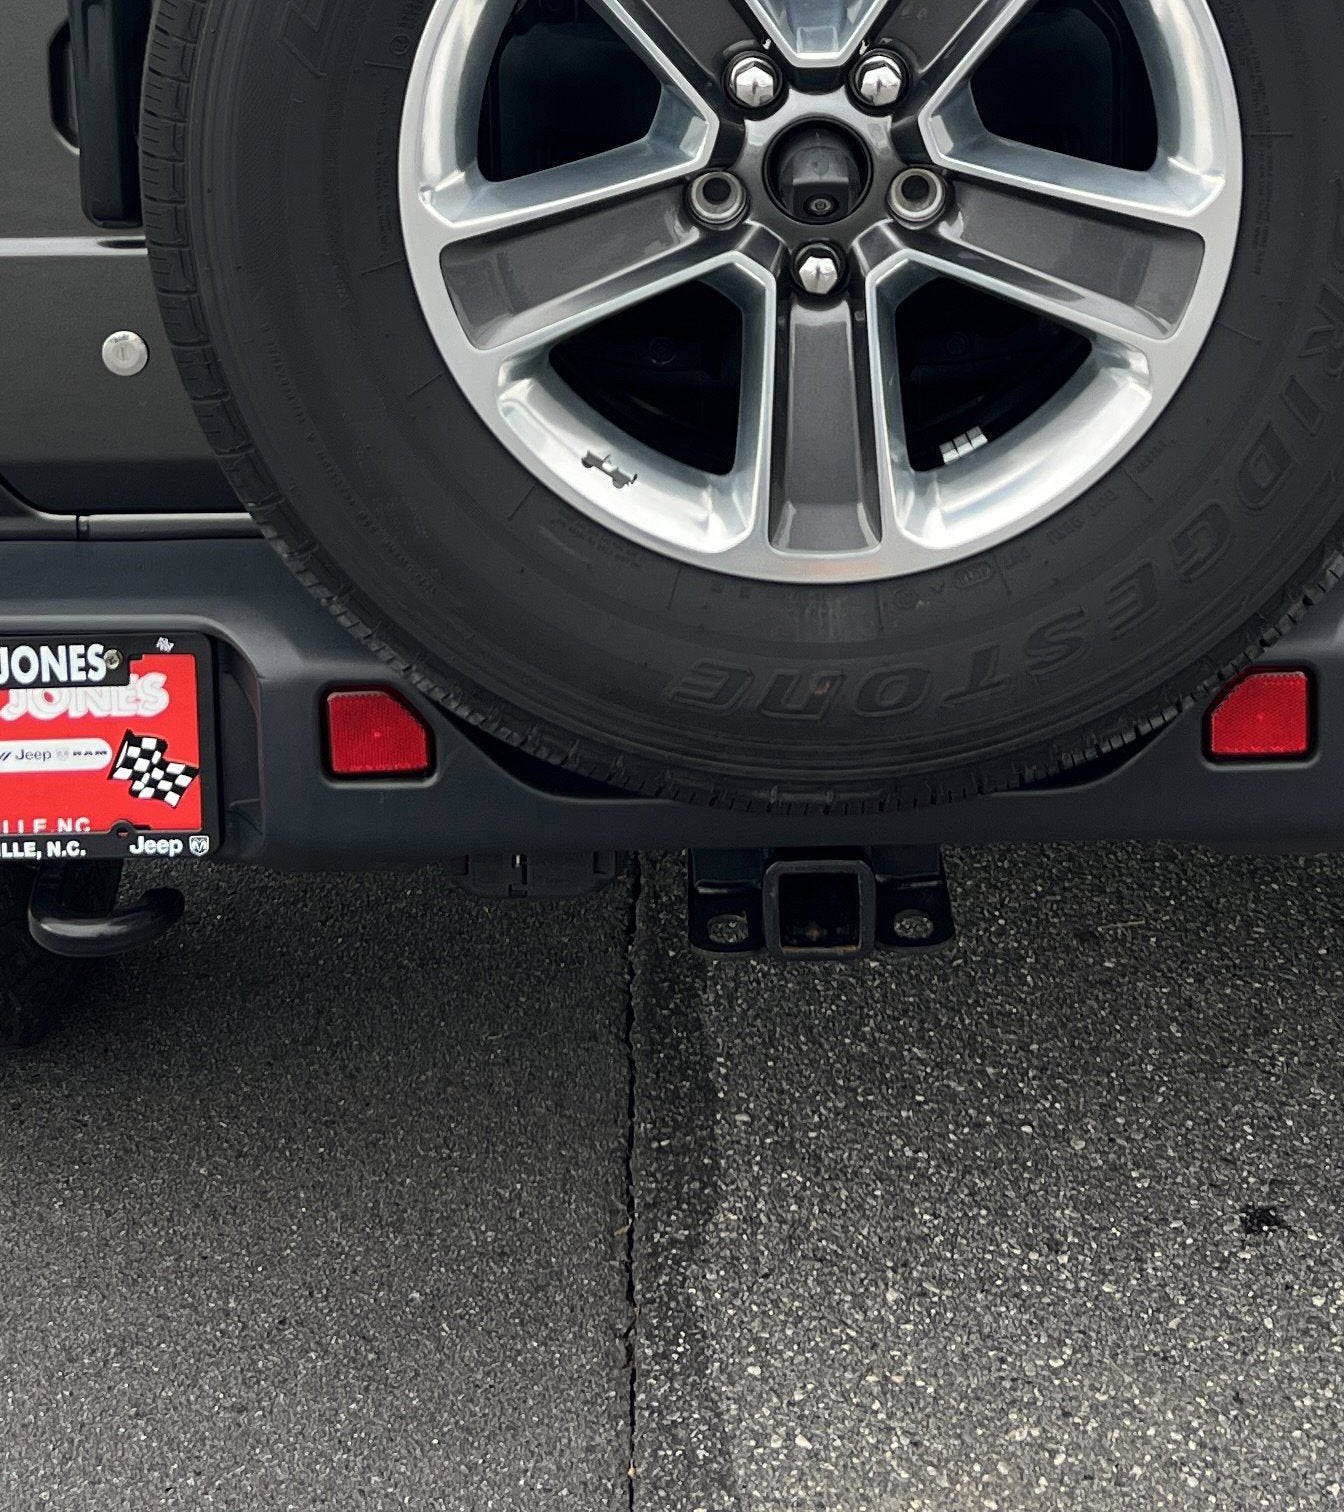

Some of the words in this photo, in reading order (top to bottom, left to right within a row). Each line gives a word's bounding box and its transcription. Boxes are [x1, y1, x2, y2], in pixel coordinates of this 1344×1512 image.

[15, 748, 52, 762] Jeep
[57, 816, 91, 833] NC
[47, 840, 87, 858] N.C.
[129, 835, 184, 857] Jeep
